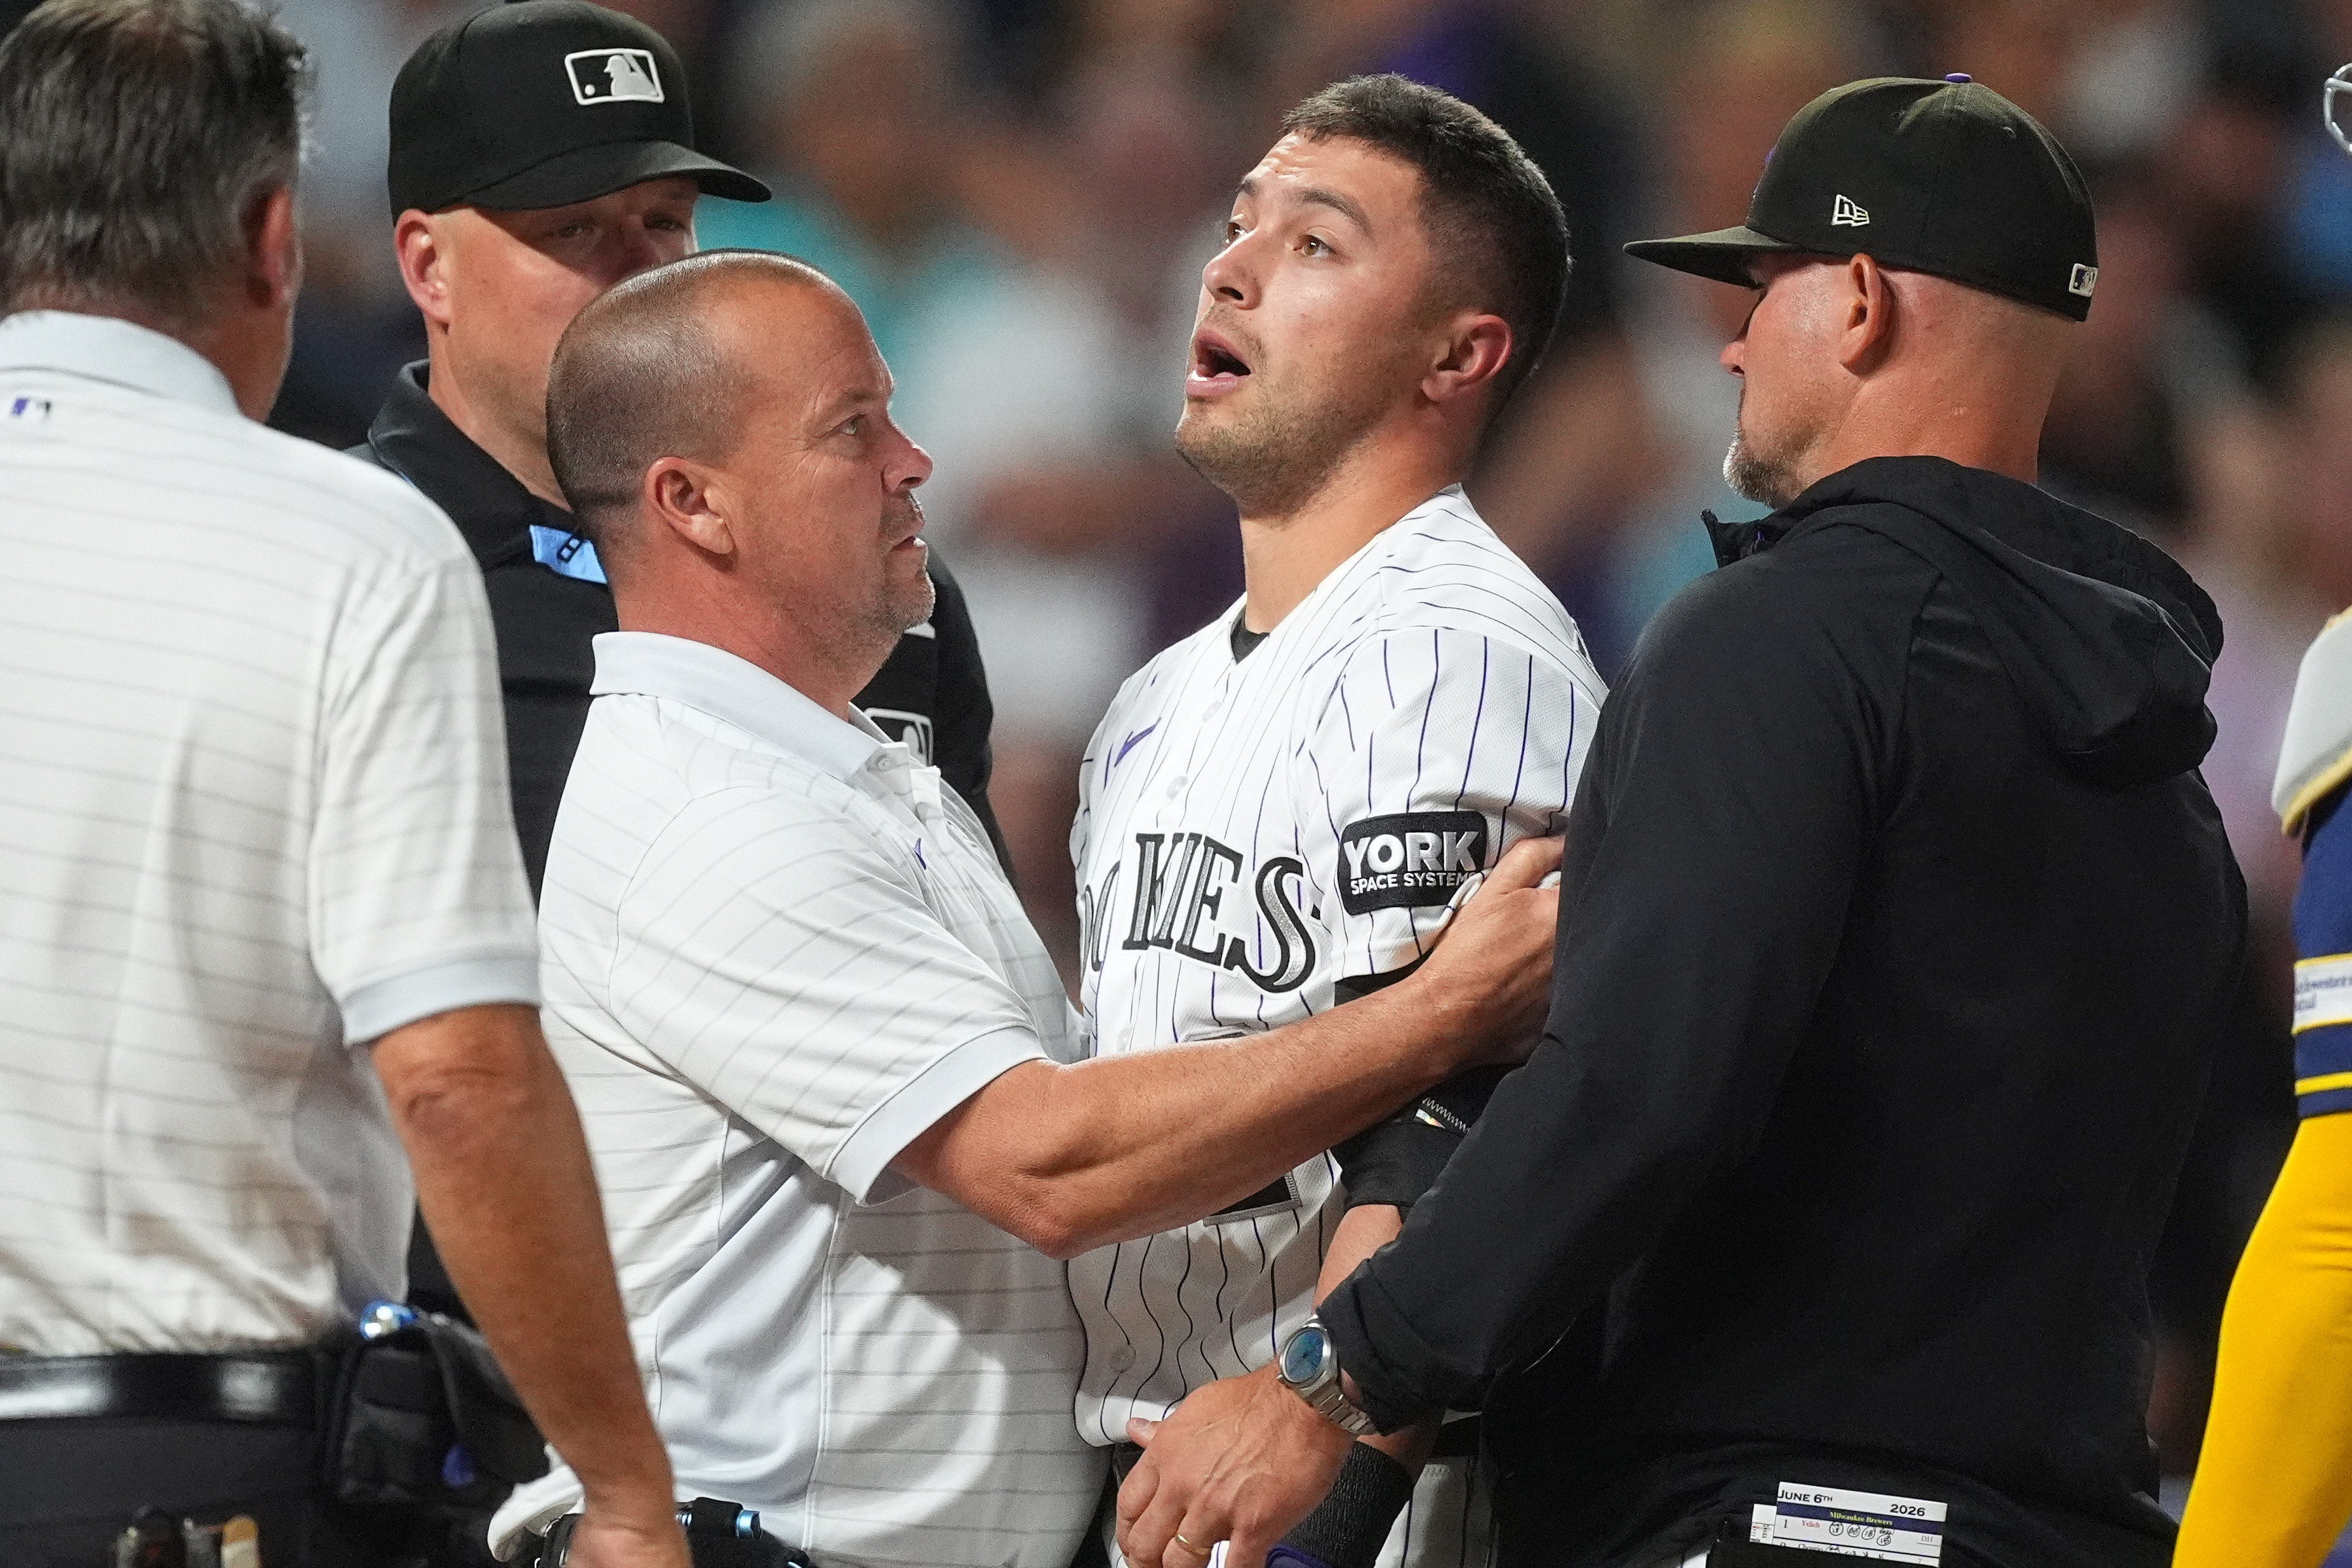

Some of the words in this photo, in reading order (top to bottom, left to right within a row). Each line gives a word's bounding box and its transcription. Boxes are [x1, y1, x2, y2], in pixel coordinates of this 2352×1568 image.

[1343, 831, 1479, 879] YORK
[1350, 874, 1399, 895] SPACE
[1778, 1489, 1811, 1502] JUNE
[1814, 1494, 1833, 1503] 6TH
[1890, 1504, 1925, 1517] 2026
[1830, 1511, 1865, 1522] Milwaukee
[1866, 1516, 1893, 1525] Brewers
